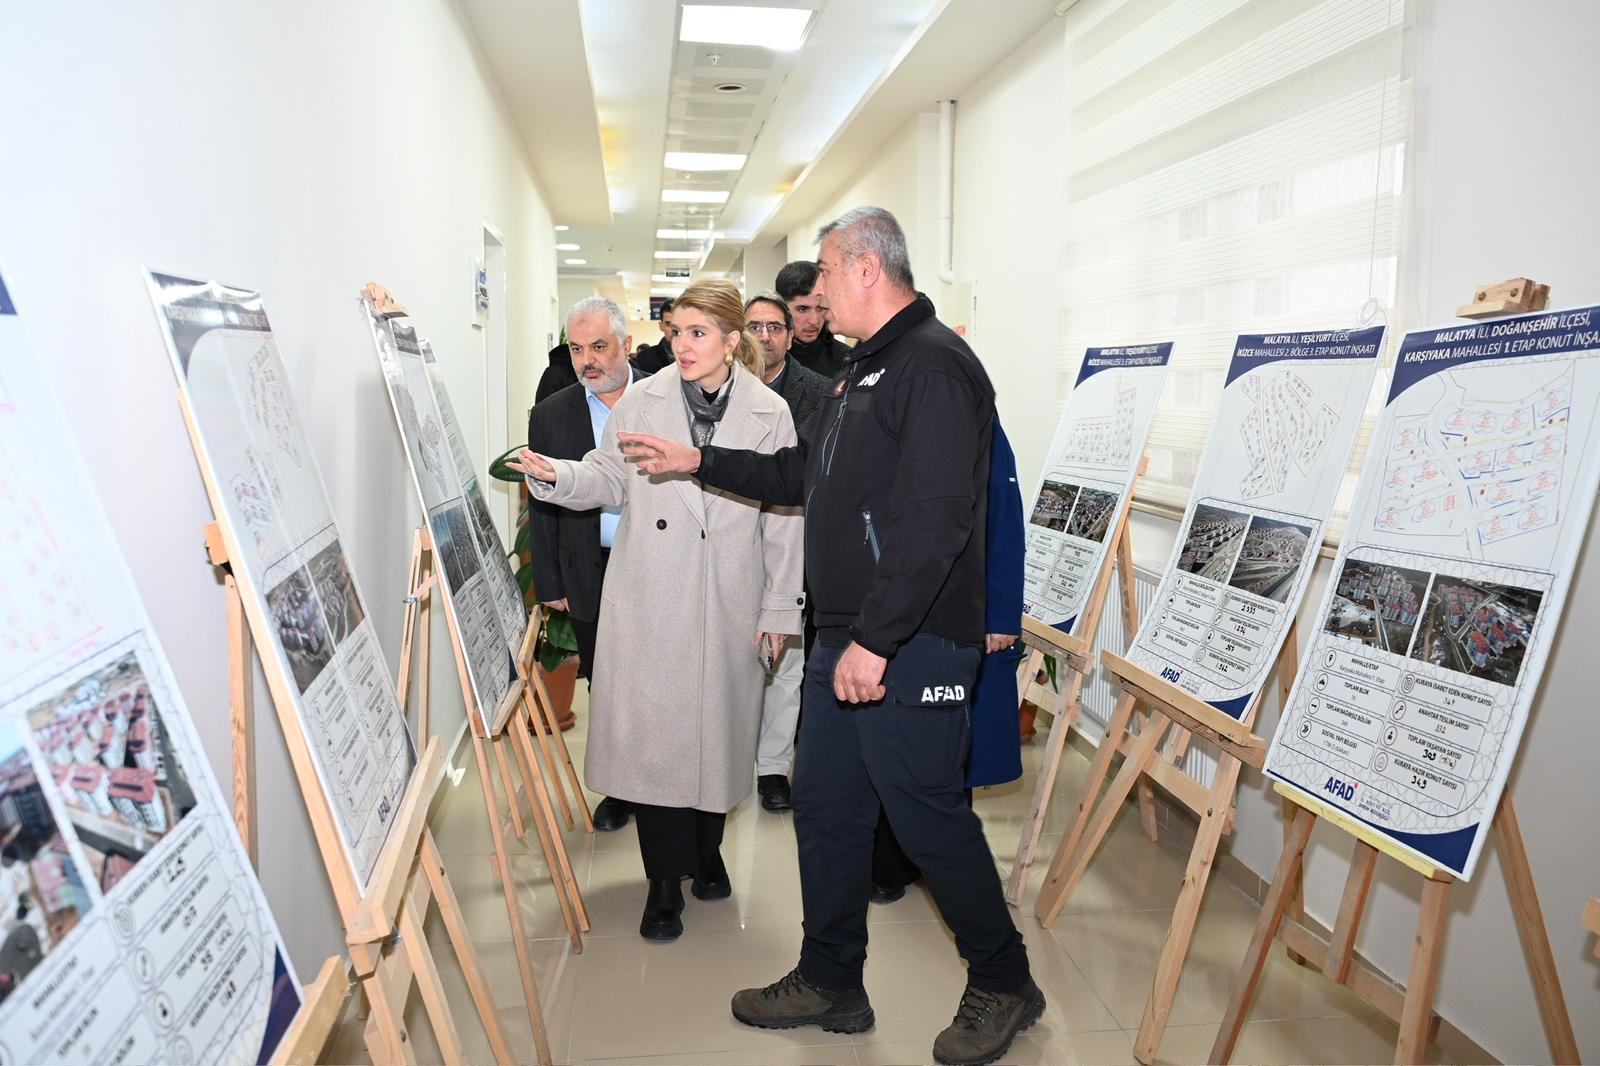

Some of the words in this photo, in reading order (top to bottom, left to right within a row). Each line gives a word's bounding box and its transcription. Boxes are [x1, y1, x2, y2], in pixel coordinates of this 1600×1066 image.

[1434, 328, 1476, 343] MALATYA
[1491, 315, 1558, 338] DOĞANŞEHİR
[1558, 310, 1592, 330] İLÇESİ,
[1263, 335, 1290, 345] MALATYA
[1404, 348, 1450, 364] KARŞIYAKA
[1451, 342, 1501, 359] MAHALLESİ
[1511, 339, 1536, 352] ETAP
[1536, 334, 1574, 350] KONUT
[1573, 330, 1600, 348] İNŞA
[1329, 346, 1351, 356] KONUT
[1160, 667, 1180, 683] AFAD
[921, 685, 965, 702] AFAD
[1460, 692, 1477, 700] KONUT
[1324, 776, 1354, 801] AFAD
